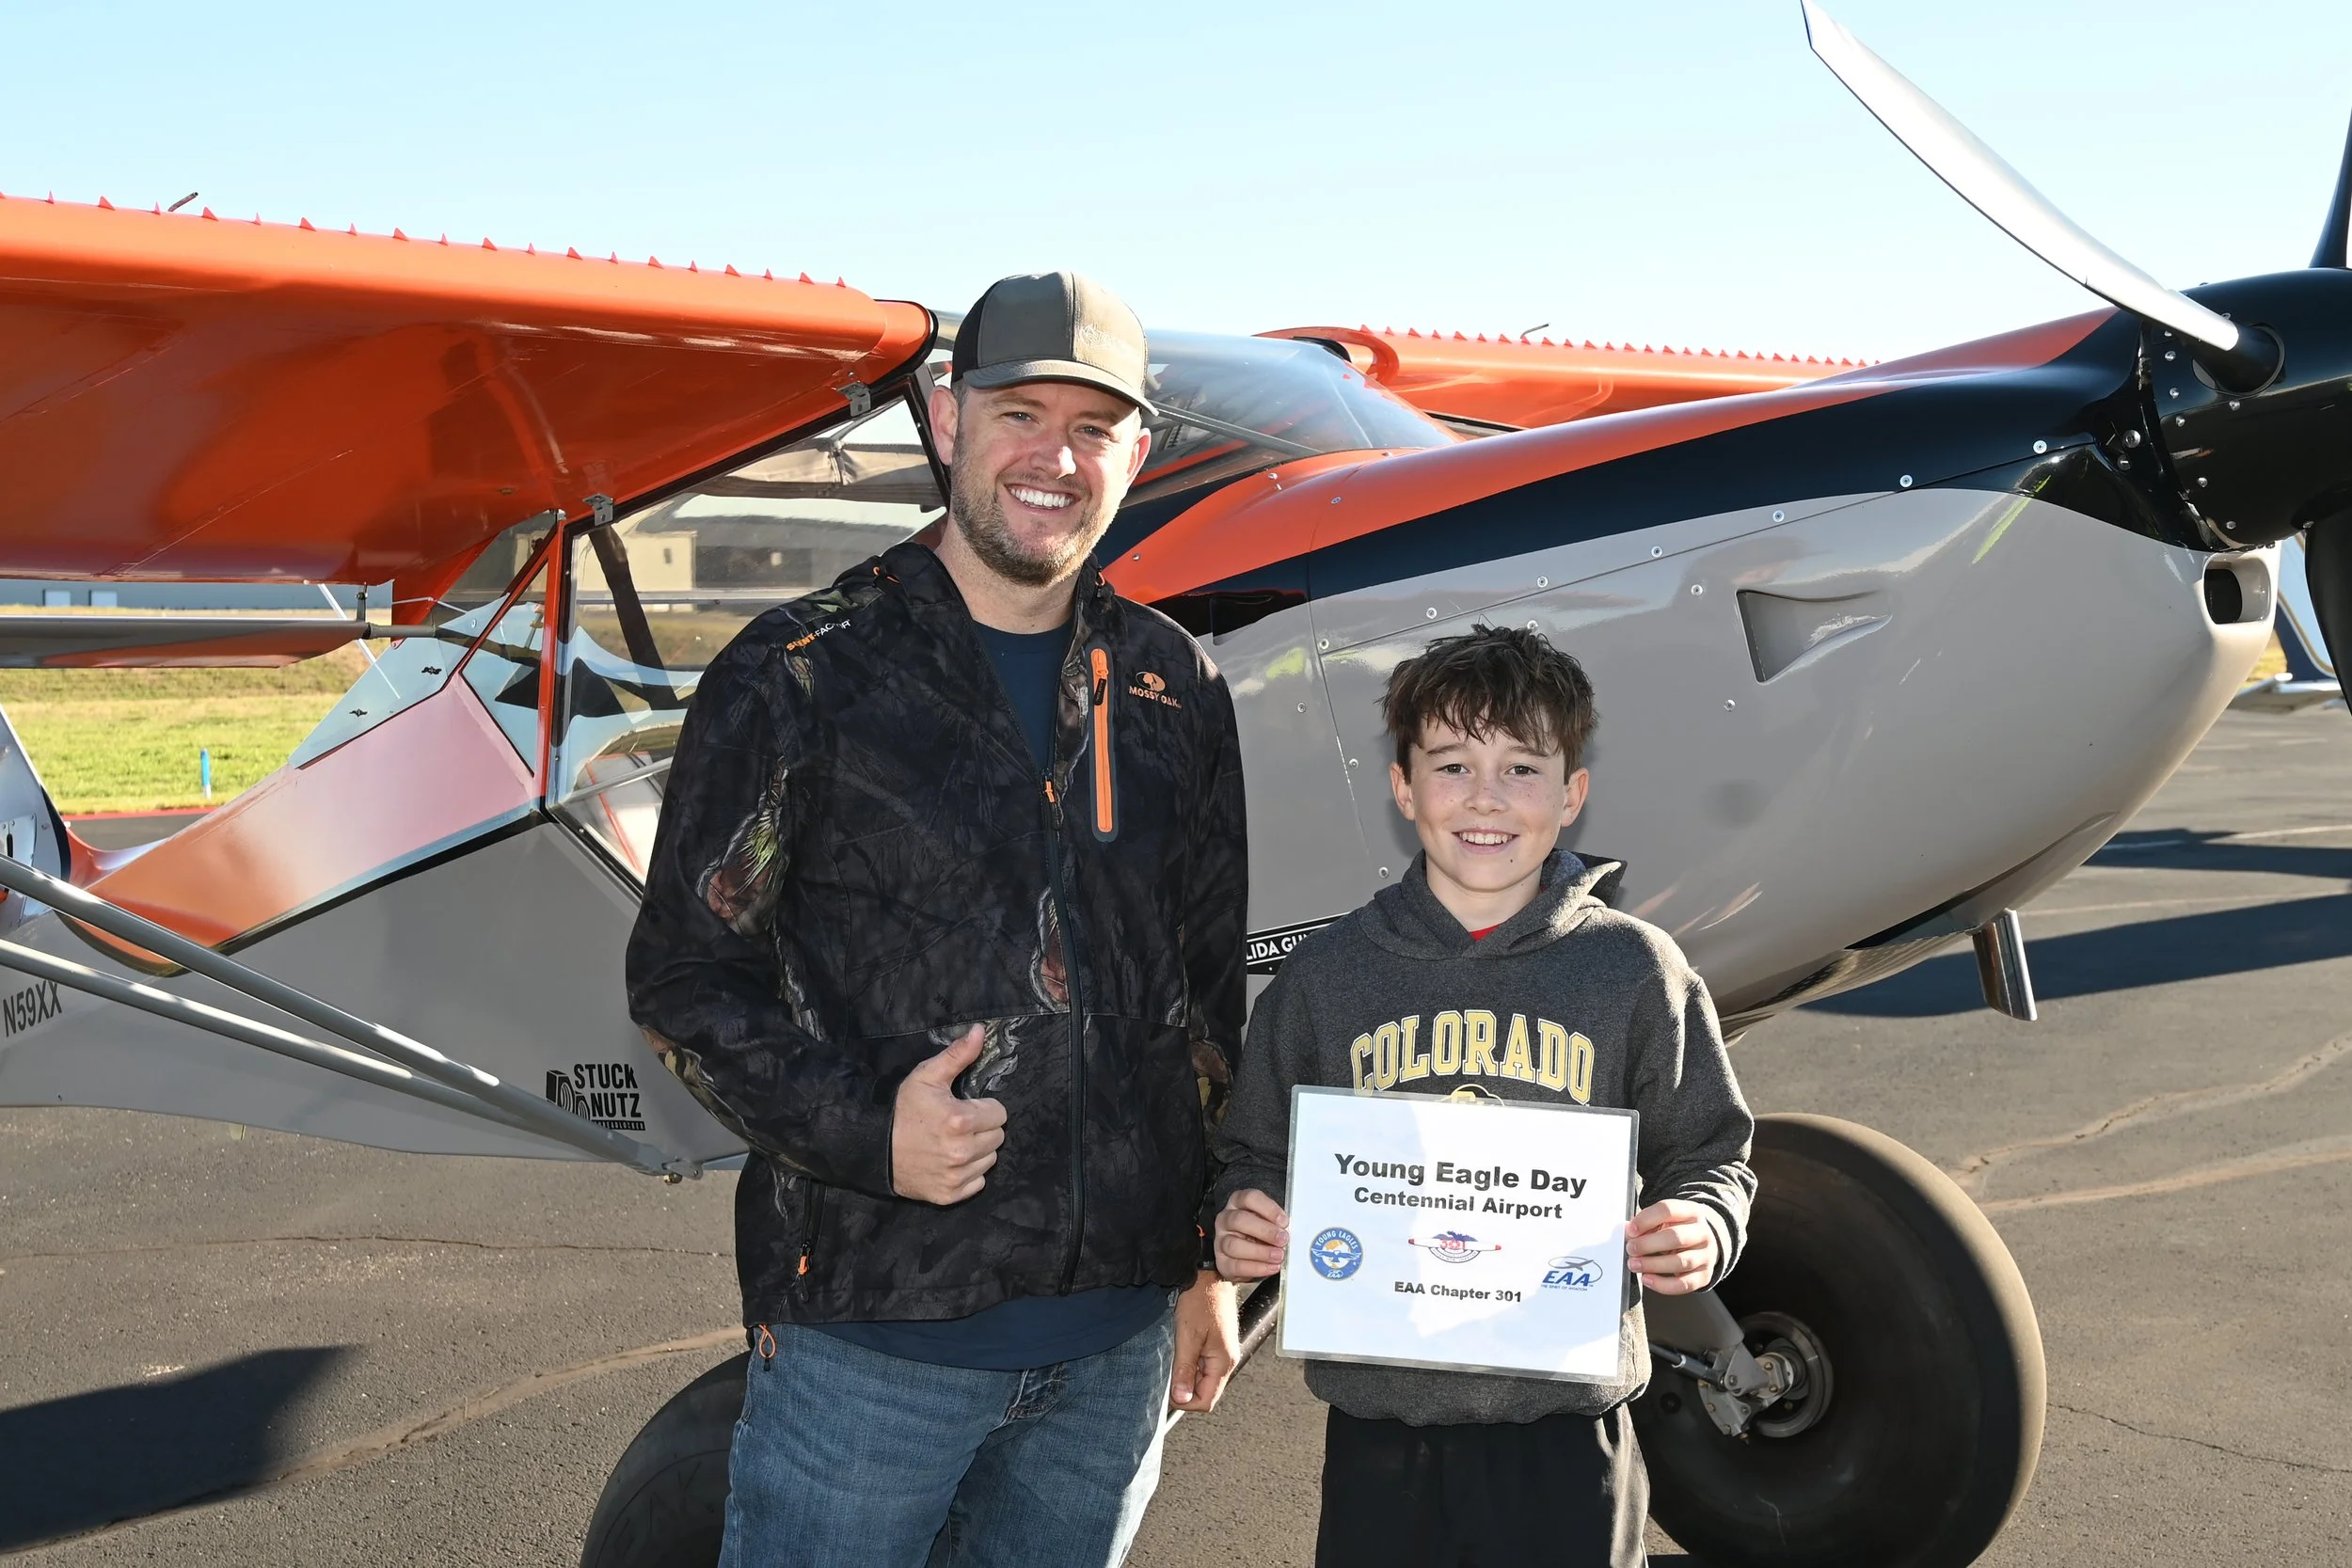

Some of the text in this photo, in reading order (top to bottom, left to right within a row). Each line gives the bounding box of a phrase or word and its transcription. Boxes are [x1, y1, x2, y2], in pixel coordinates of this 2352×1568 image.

[1129, 686, 1178, 707] MOSSY OAK
[1281, 934, 1307, 952] GU
[3, 979, 62, 1037] N59XX
[1350, 1009, 1595, 1105] COLORADO
[574, 1063, 638, 1089] STUCK
[591, 1092, 641, 1117] NUTZ
[1334, 1153, 1587, 1198] Young Eagle Day
[1354, 1187, 1563, 1219] Centennial Airport
[1315, 1230, 1336, 1246] YOUNG
[1542, 1270, 1590, 1287] EAA
[1394, 1281, 1521, 1302] EAA Chapter 301
